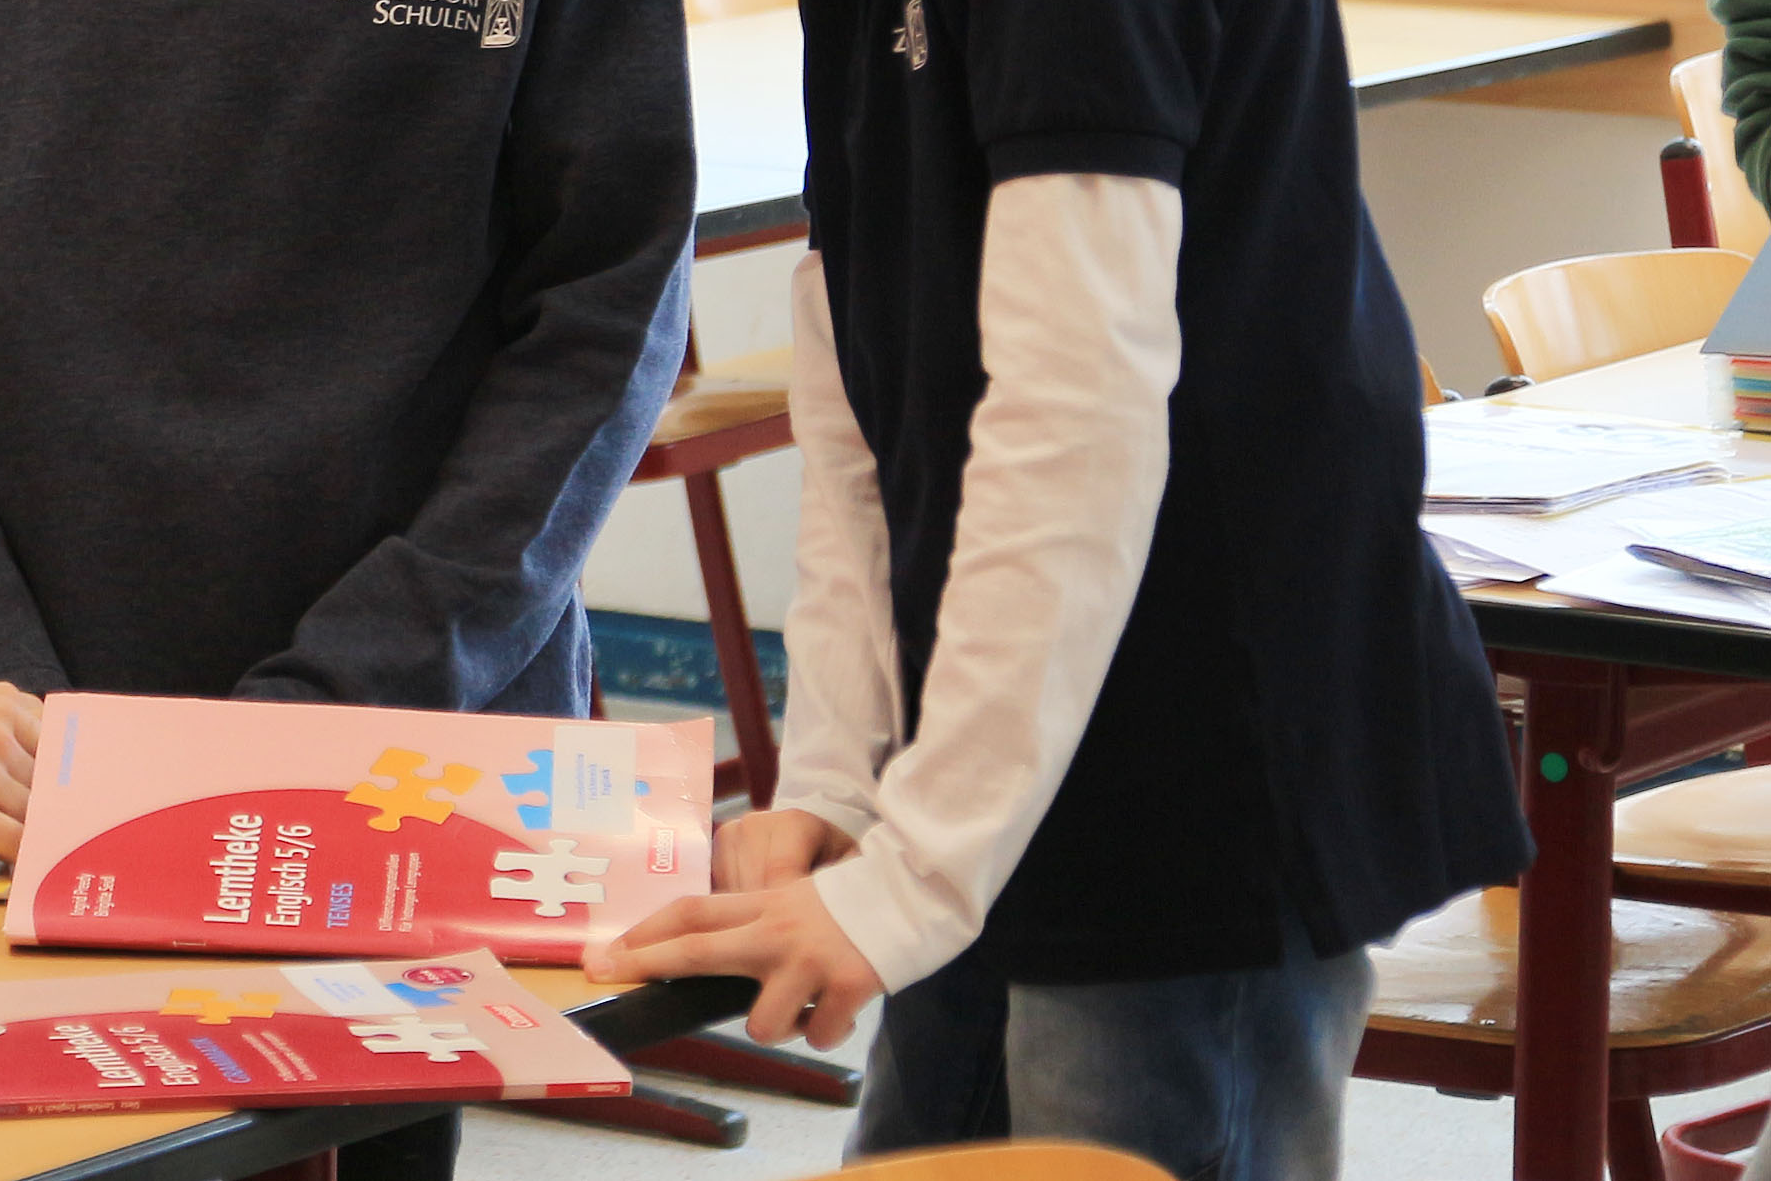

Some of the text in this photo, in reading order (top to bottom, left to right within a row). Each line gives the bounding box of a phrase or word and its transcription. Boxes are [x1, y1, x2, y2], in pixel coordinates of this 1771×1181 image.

[373, 0, 480, 32] SCHULEN
[204, 814, 263, 923] Lerntheke
[265, 825, 316, 927] Englisch 5/6
[327, 883, 354, 928] TENSES
[49, 1024, 146, 1088] Lerntheke
[108, 1026, 200, 1086] Englisch 5/6
